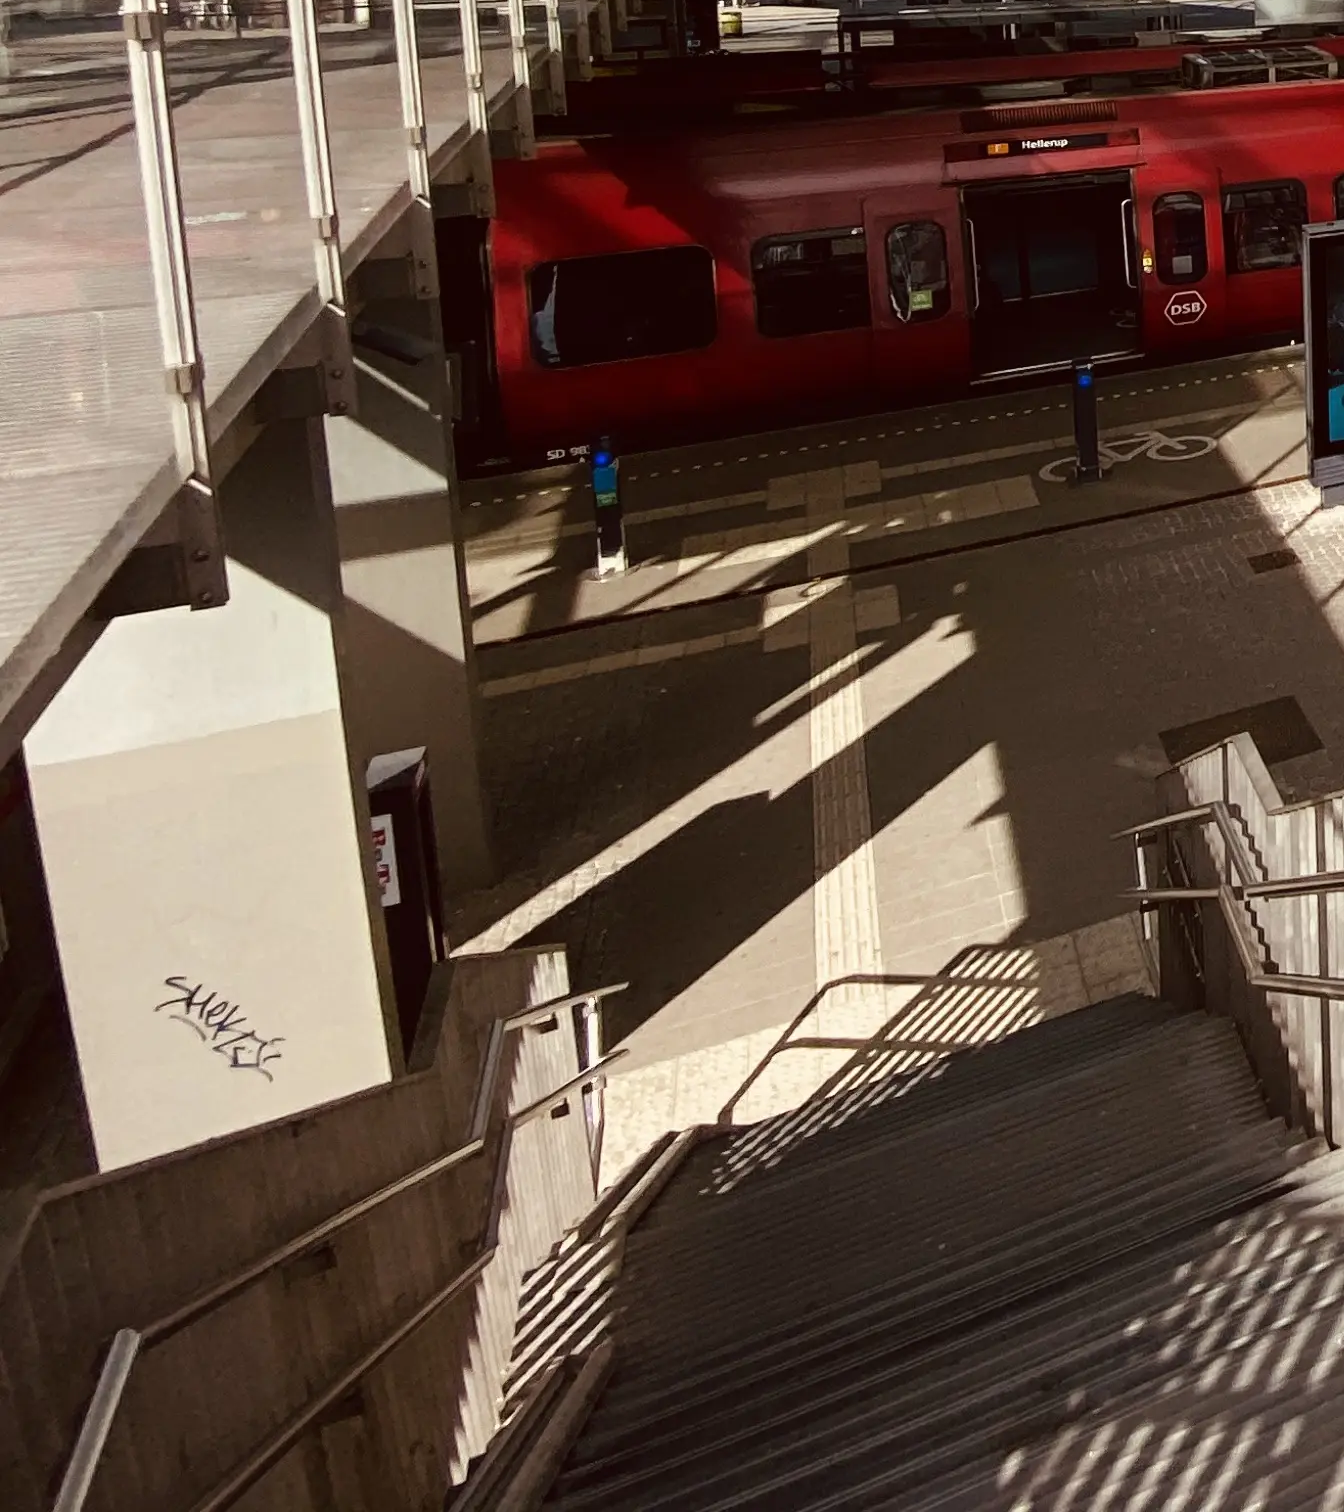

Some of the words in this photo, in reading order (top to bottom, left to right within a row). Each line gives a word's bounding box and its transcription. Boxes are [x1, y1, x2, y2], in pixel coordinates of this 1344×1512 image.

[1022, 139, 1069, 150] Hellerup
[1171, 302, 1201, 316] DSB
[546, 449, 566, 461] SD
